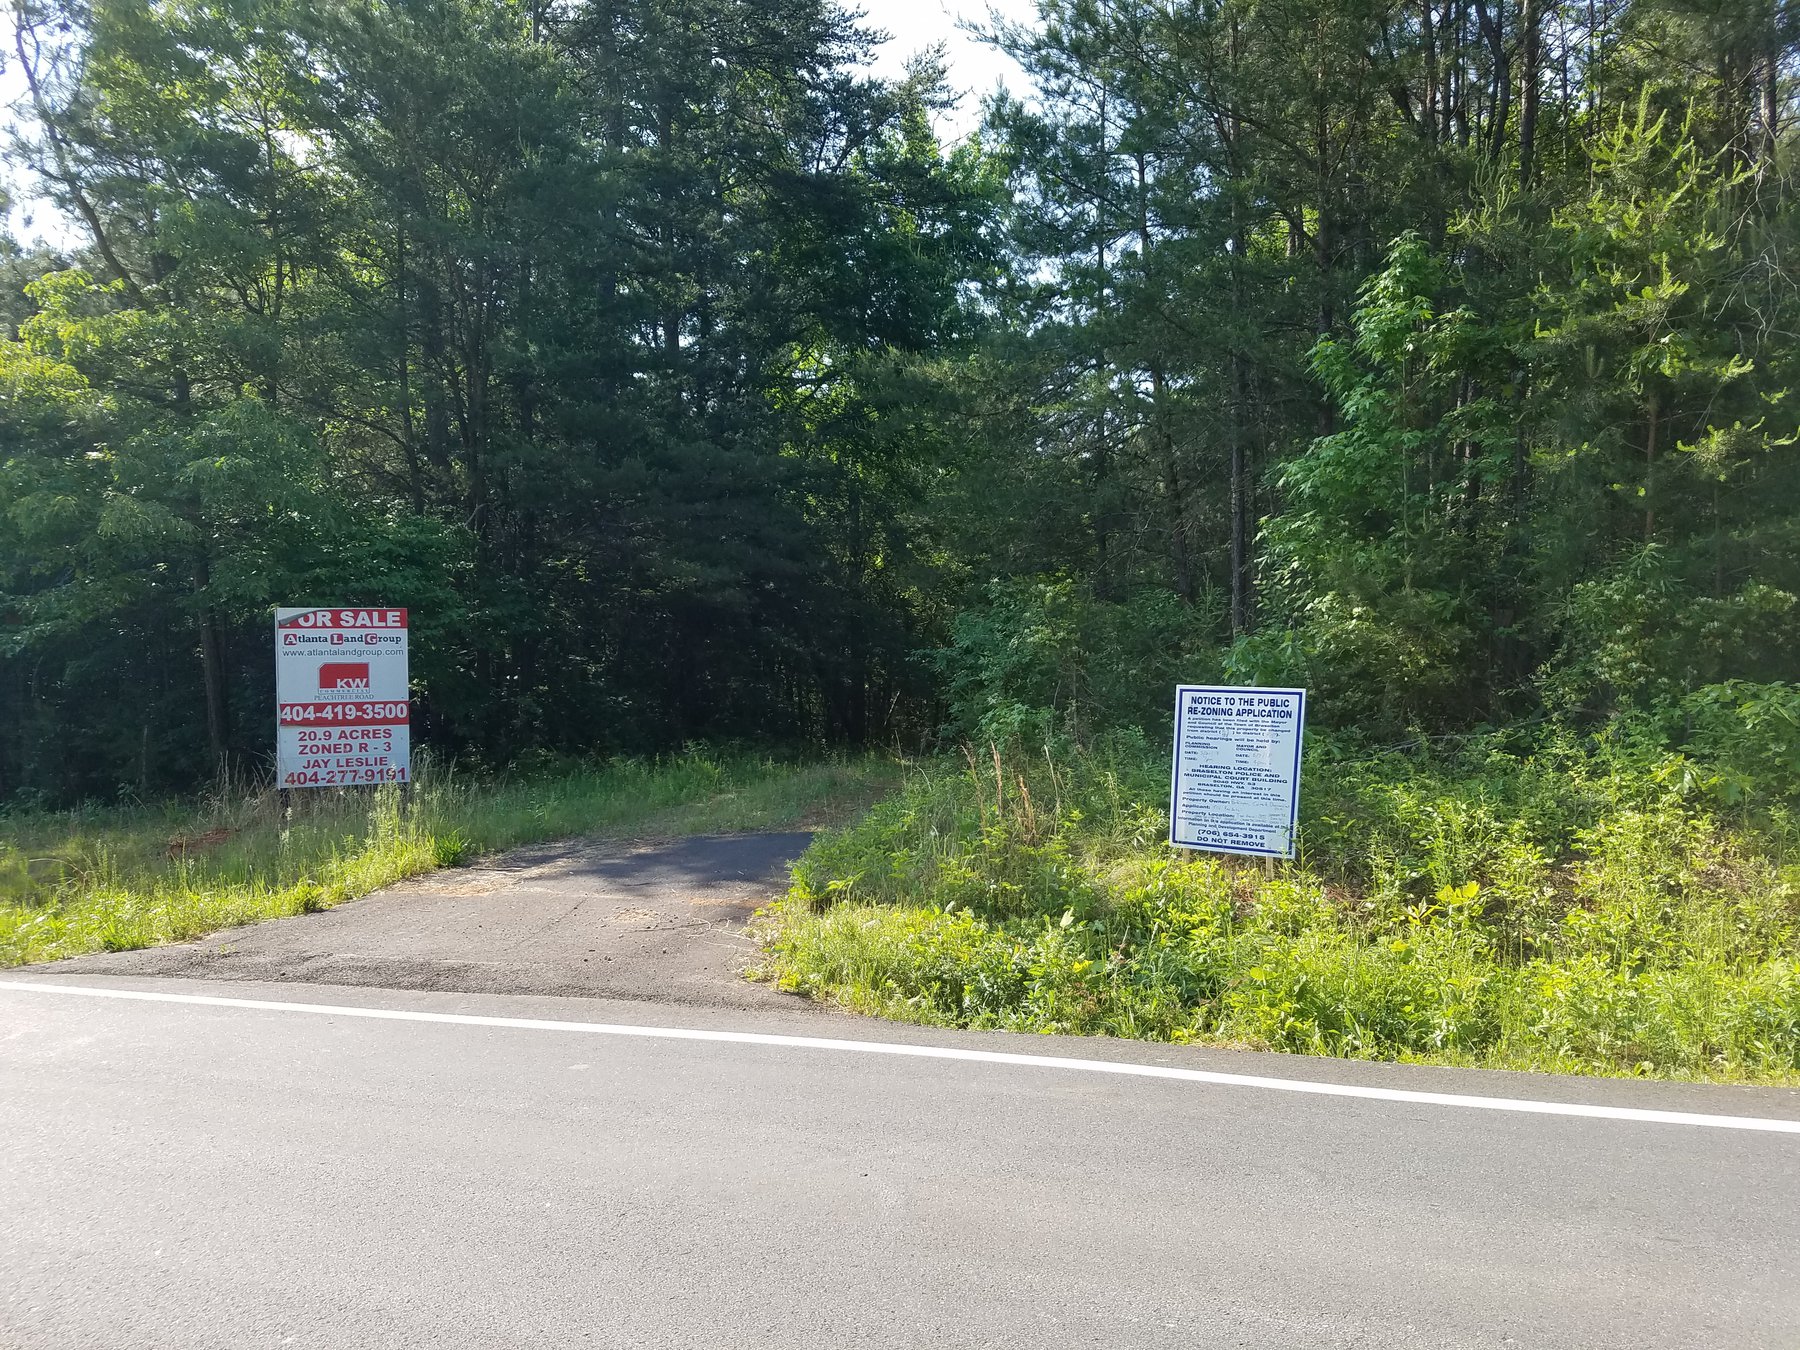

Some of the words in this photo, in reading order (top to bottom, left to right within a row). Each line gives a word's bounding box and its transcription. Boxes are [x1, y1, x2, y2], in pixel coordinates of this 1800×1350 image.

[280, 611, 332, 626] OR
[340, 611, 401, 627] SALE
[284, 634, 328, 645] Atlanta
[330, 633, 363, 645] Land
[364, 633, 402, 645] Group
[283, 648, 403, 657] www.atlantalandgroup.com
[336, 678, 368, 688] KW
[1191, 696, 1222, 705] NOTICE
[1224, 697, 1235, 706] TO
[1239, 698, 1255, 706] THE
[1257, 698, 1290, 707] PUBLIC
[281, 703, 407, 721] 404-419-3500
[1188, 707, 1233, 717] RE-ZONING
[1236, 709, 1292, 719] APPLICATION
[298, 730, 332, 742] 20.9
[338, 729, 392, 740] ACRES
[298, 743, 352, 755] ZONED
[358, 742, 369, 752] R
[383, 742, 391, 752] 3
[303, 758, 331, 769] JAY
[336, 757, 388, 768] LESLIE
[285, 768, 405, 785] 404-277-9191
[1223, 832, 1265, 840] 654-3915
